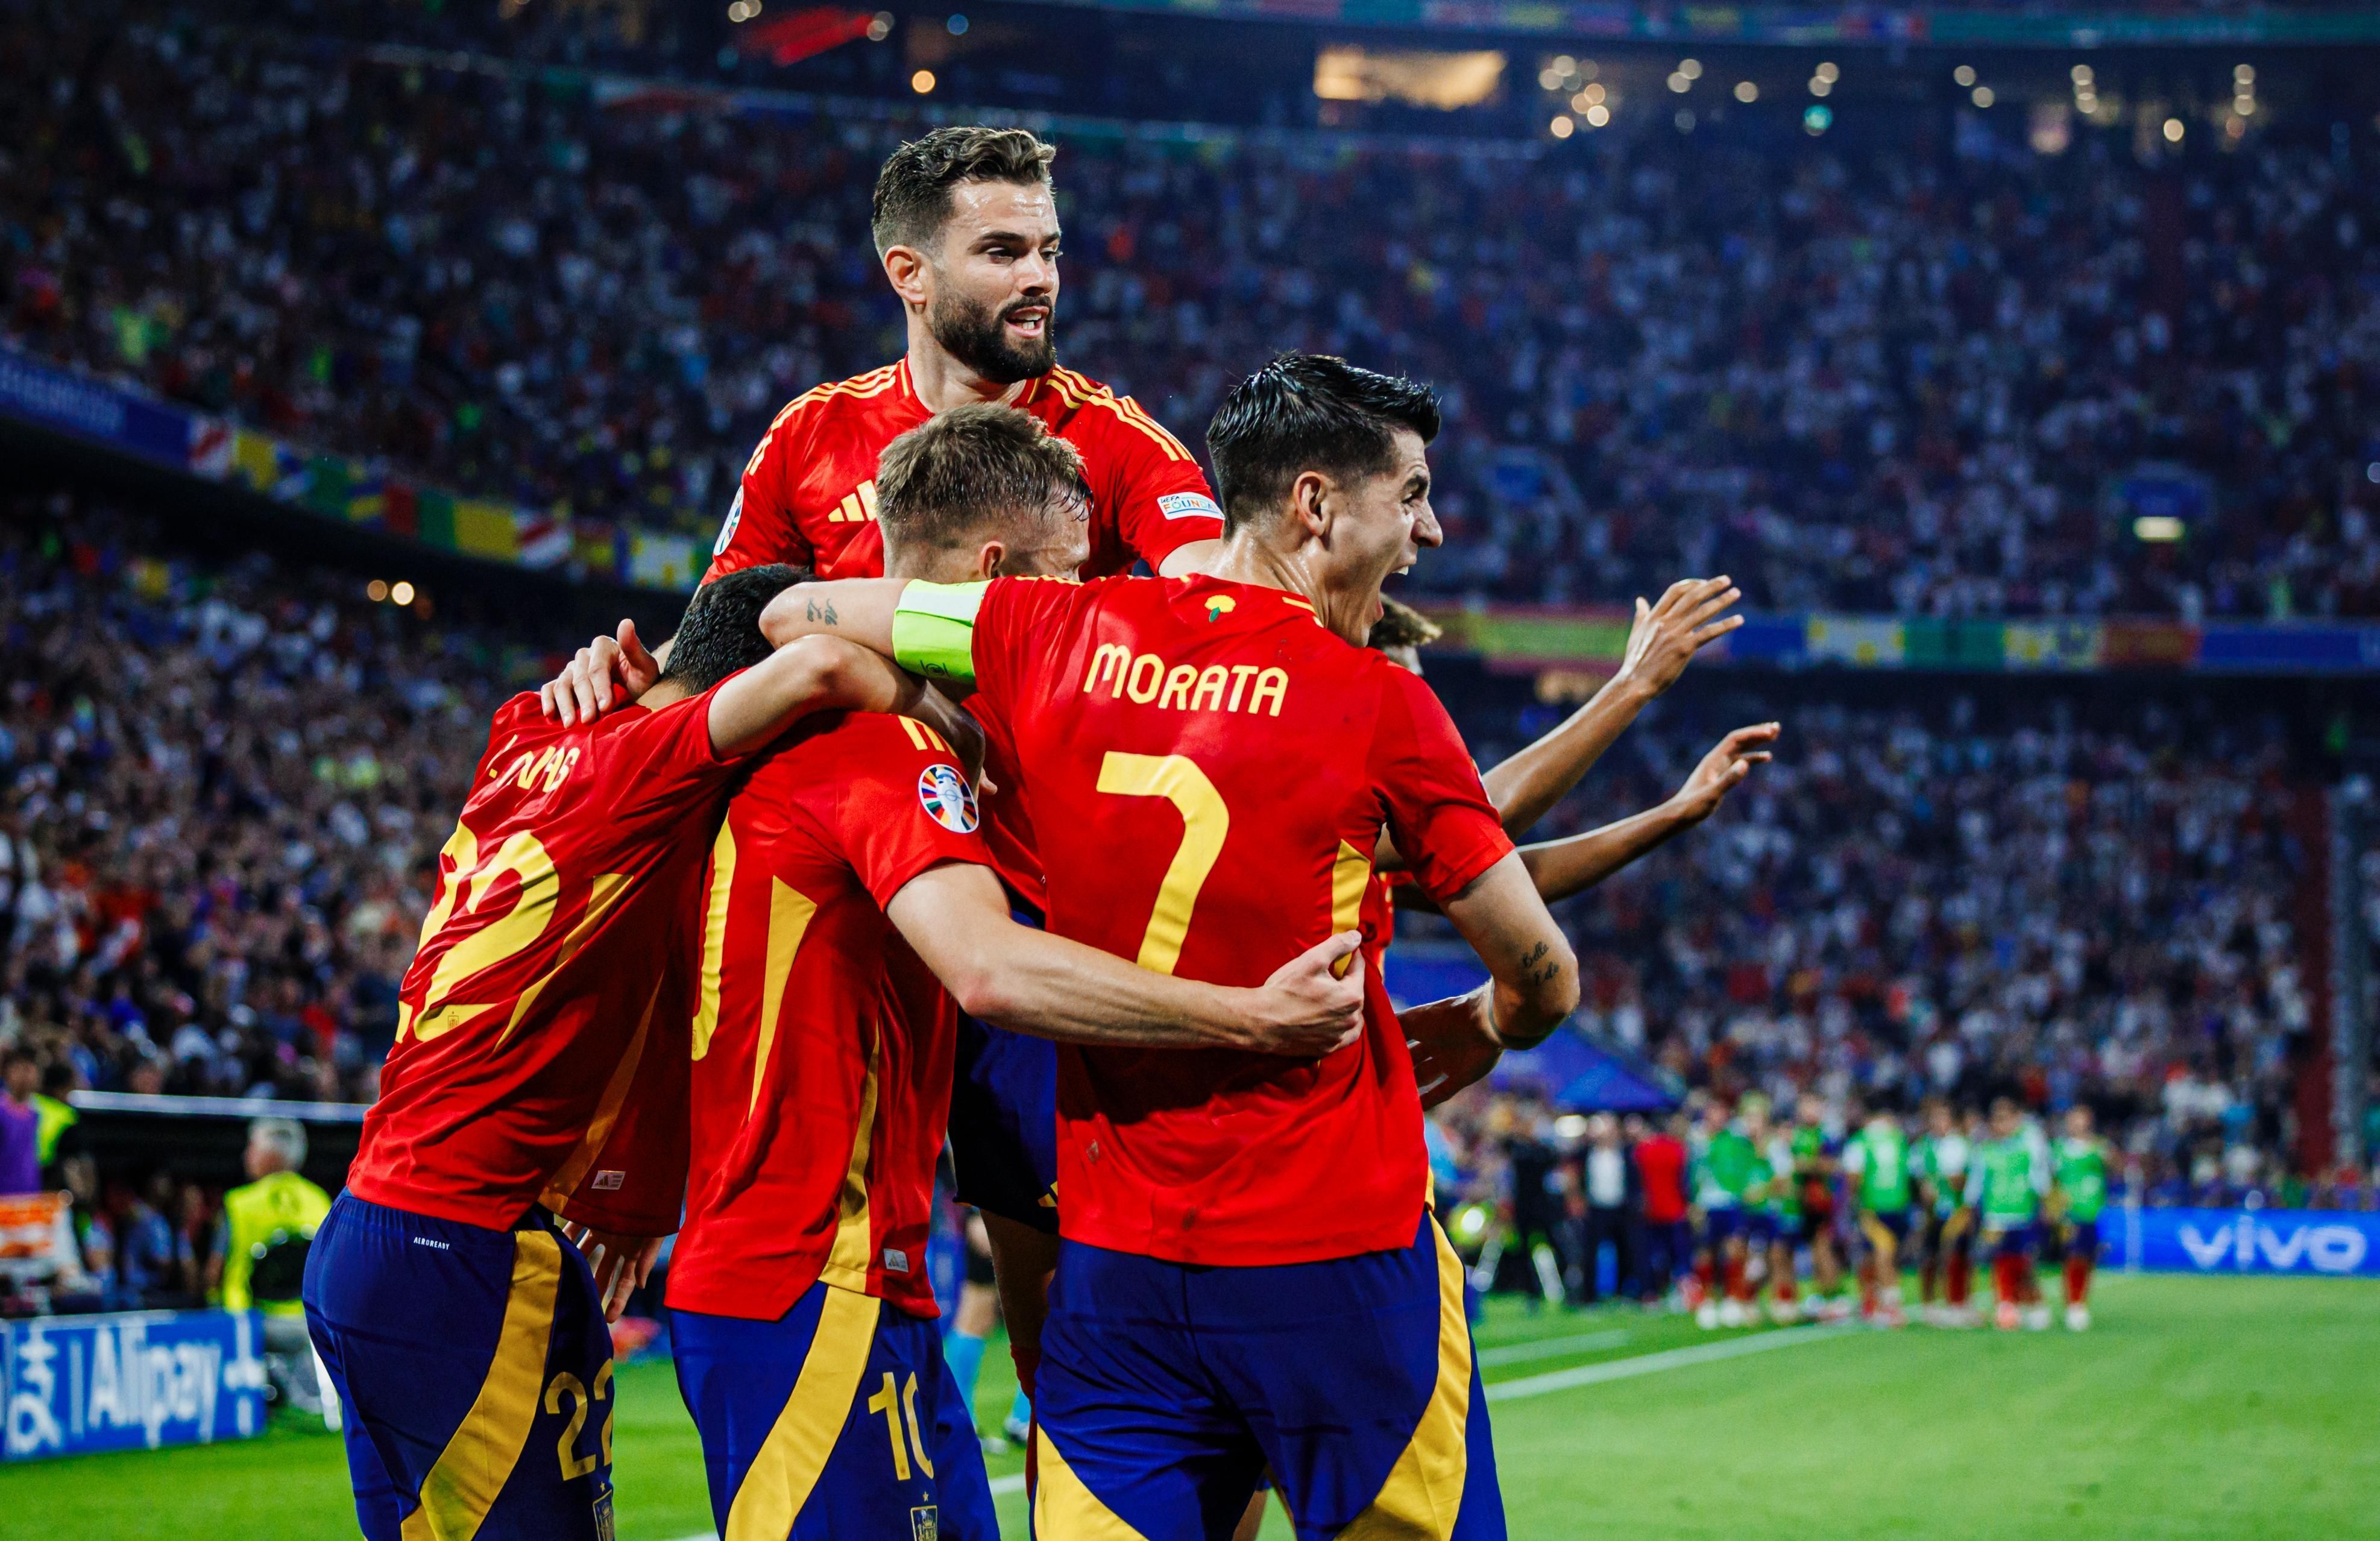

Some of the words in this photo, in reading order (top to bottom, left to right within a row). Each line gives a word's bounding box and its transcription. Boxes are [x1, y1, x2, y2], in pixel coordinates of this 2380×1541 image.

[1160, 496, 1180, 504] UEFA
[1084, 643, 1289, 717] MORATA
[1096, 751, 1229, 975] 7
[414, 1237, 450, 1250] AEROREADY
[2178, 1213, 2367, 1273] vivo
[868, 1371, 934, 1481] 10
